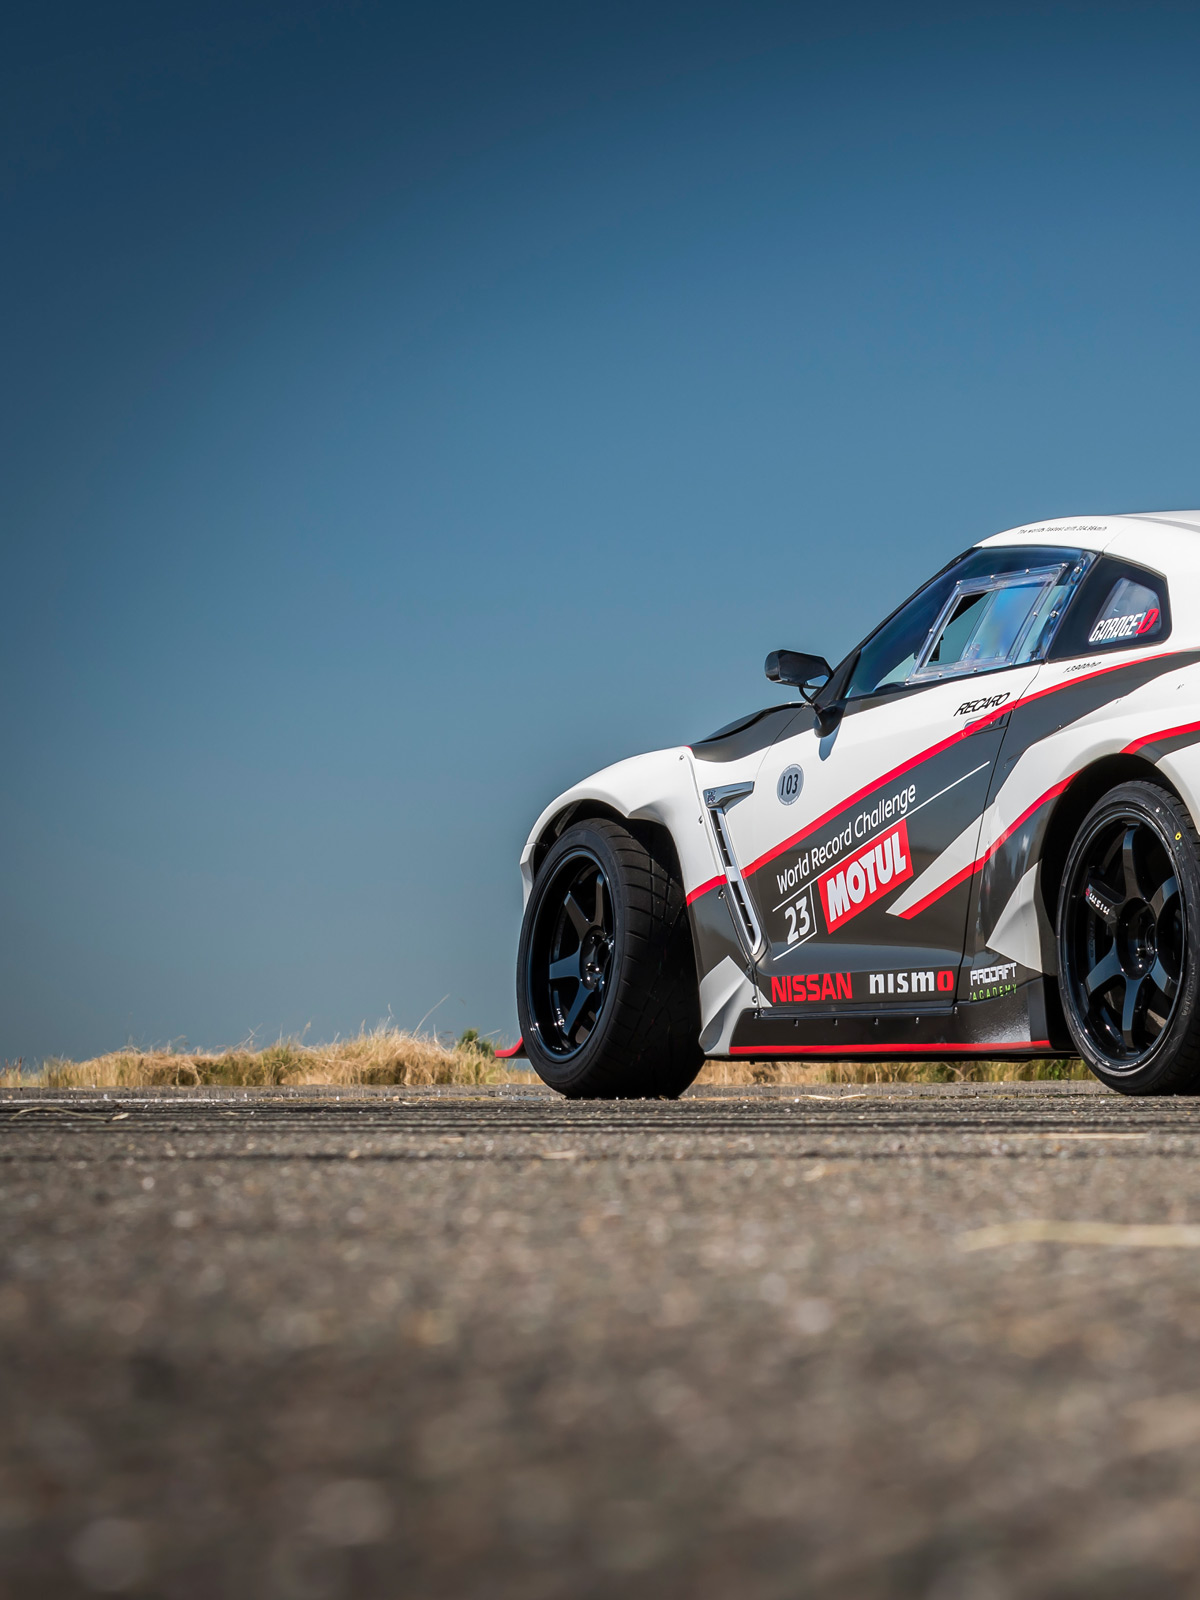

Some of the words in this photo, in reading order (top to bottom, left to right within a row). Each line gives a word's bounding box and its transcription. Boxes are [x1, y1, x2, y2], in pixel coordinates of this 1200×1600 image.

[953, 692, 1010, 717] RECARO
[781, 774, 799, 796] 103
[777, 861, 809, 894] World
[811, 822, 852, 870] Record
[855, 783, 916, 838] Challenge
[827, 831, 907, 922] MOTUL
[784, 897, 811, 945] 23
[770, 972, 853, 1002] NISSAN
[869, 971, 954, 994] nismo
[973, 984, 1017, 1001] ACADEMY
